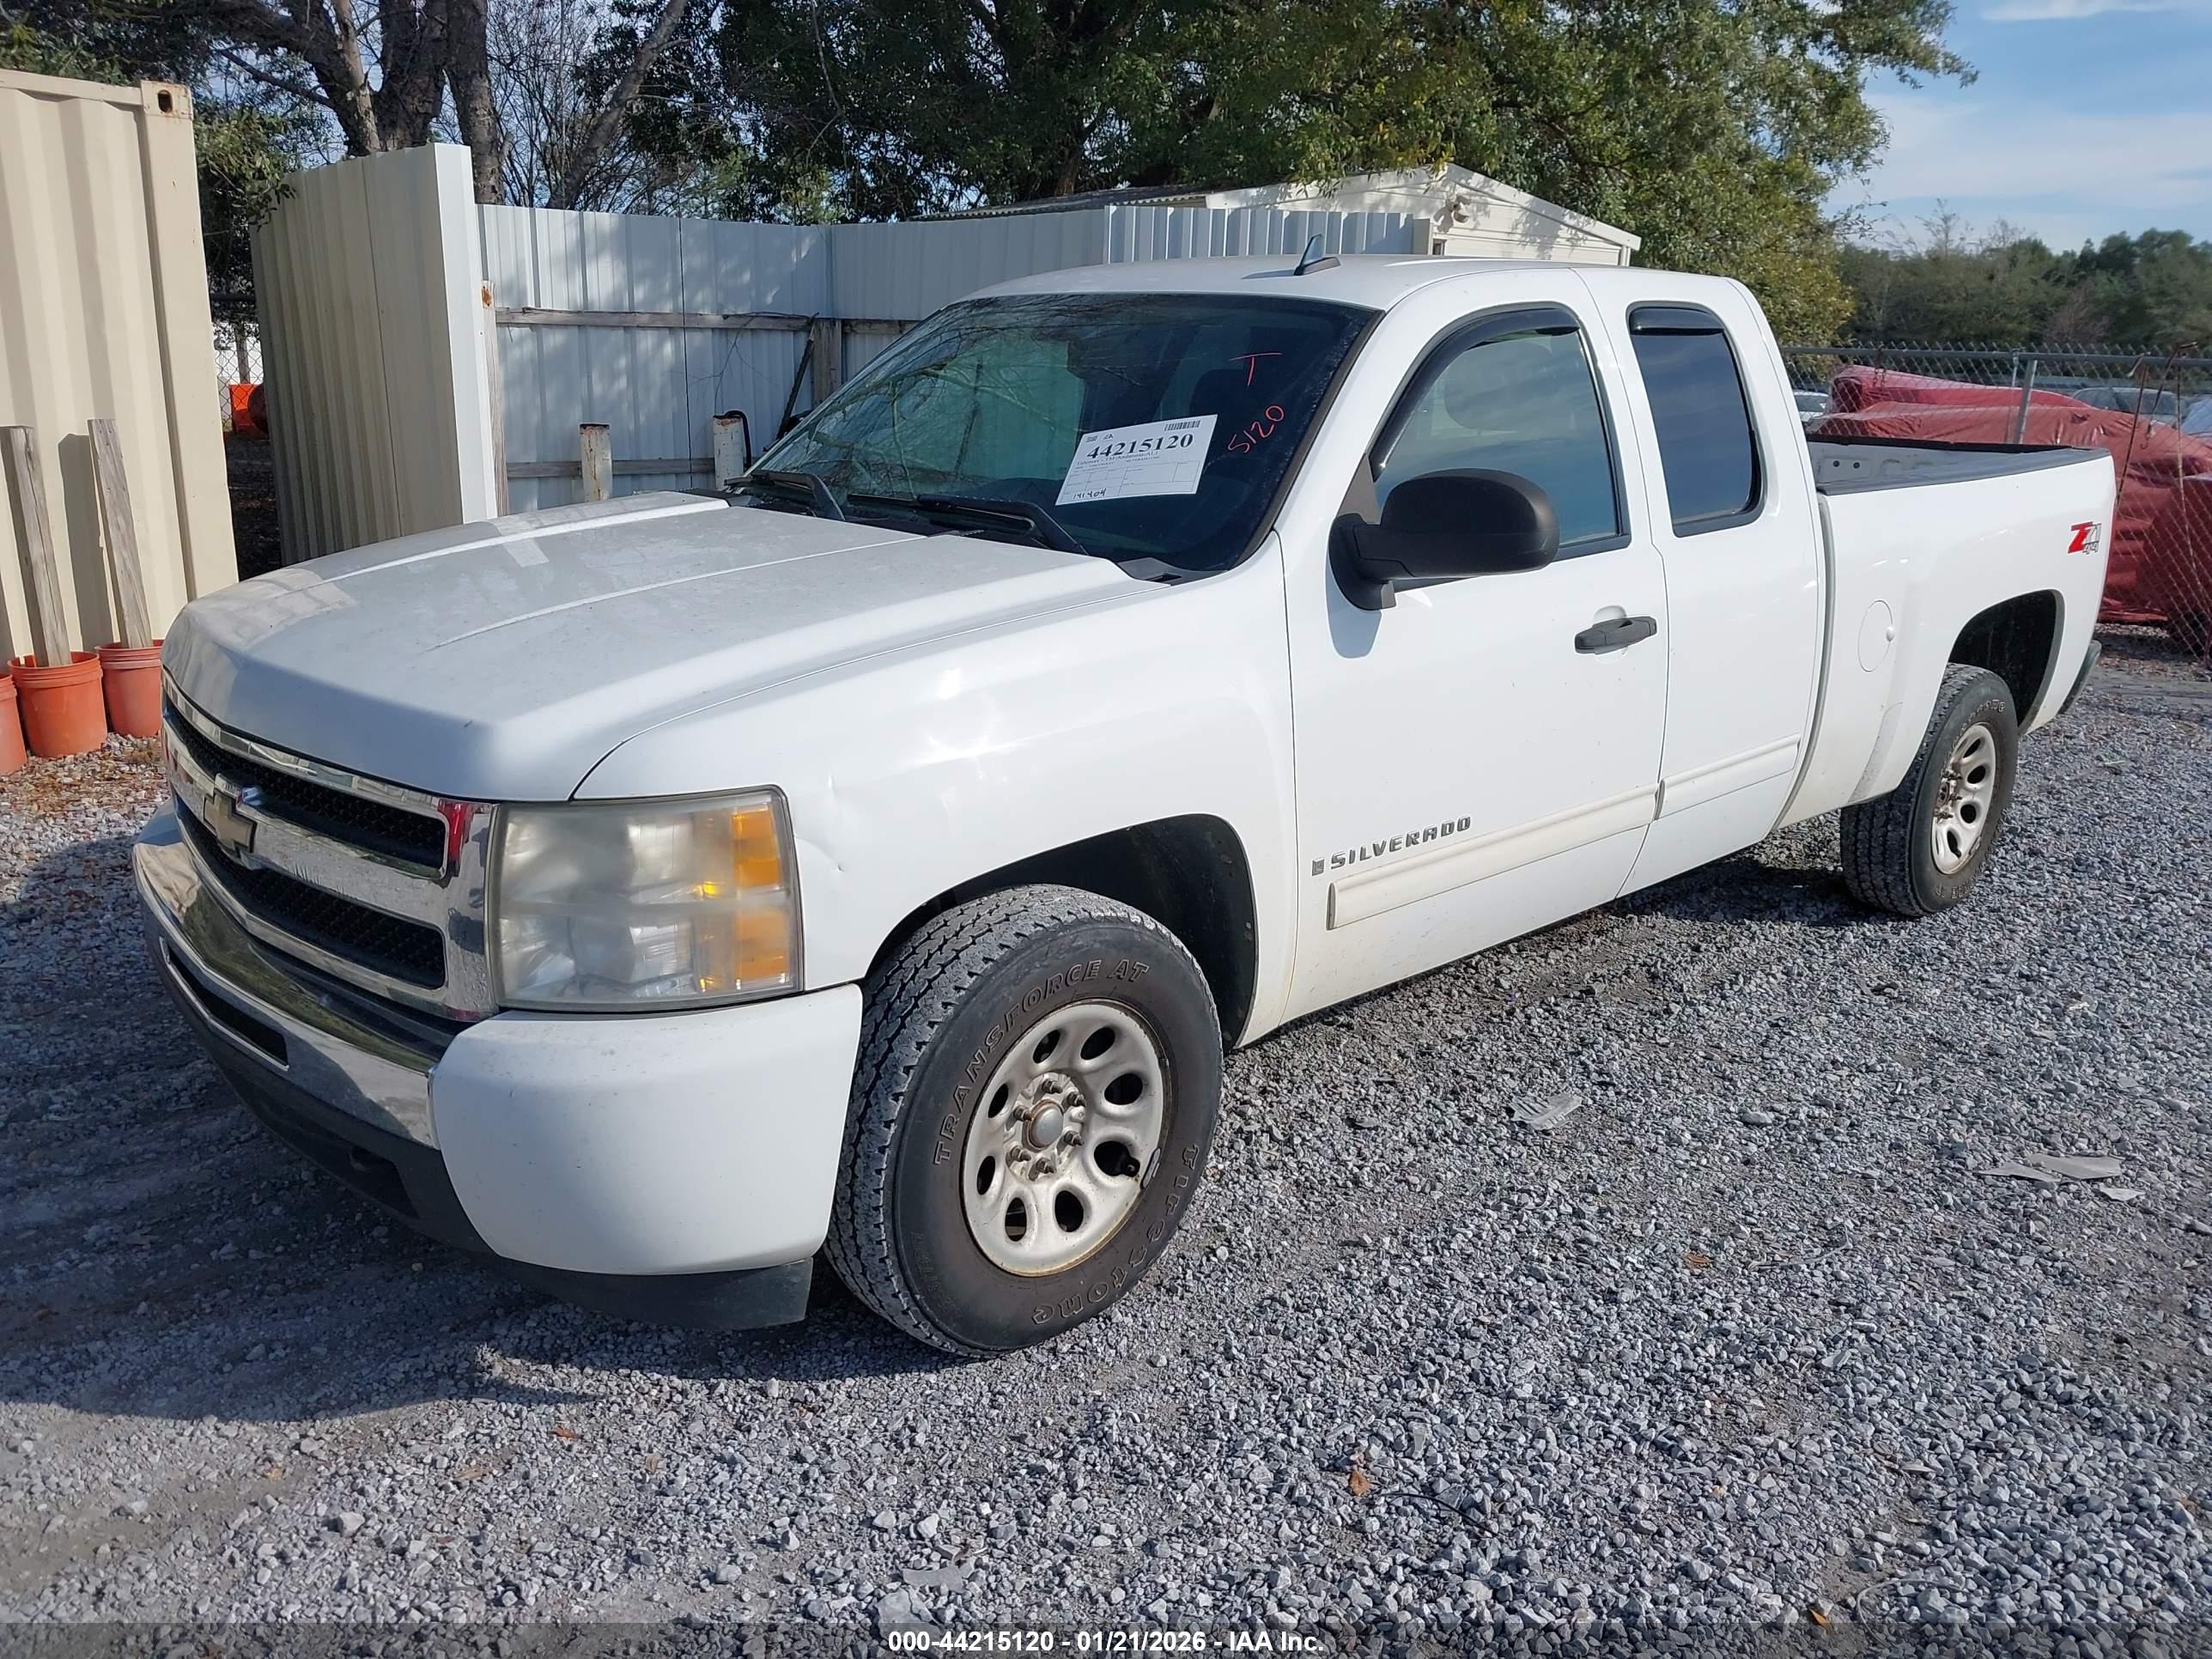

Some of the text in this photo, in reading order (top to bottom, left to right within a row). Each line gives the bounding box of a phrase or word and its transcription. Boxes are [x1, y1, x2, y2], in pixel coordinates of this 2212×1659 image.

[1086, 433, 1194, 459] 44215120
[1227, 404, 1285, 453] 5120
[1330, 815, 1472, 870] SILVERADO
[933, 958, 1151, 1165] TRANSFORCE AT
